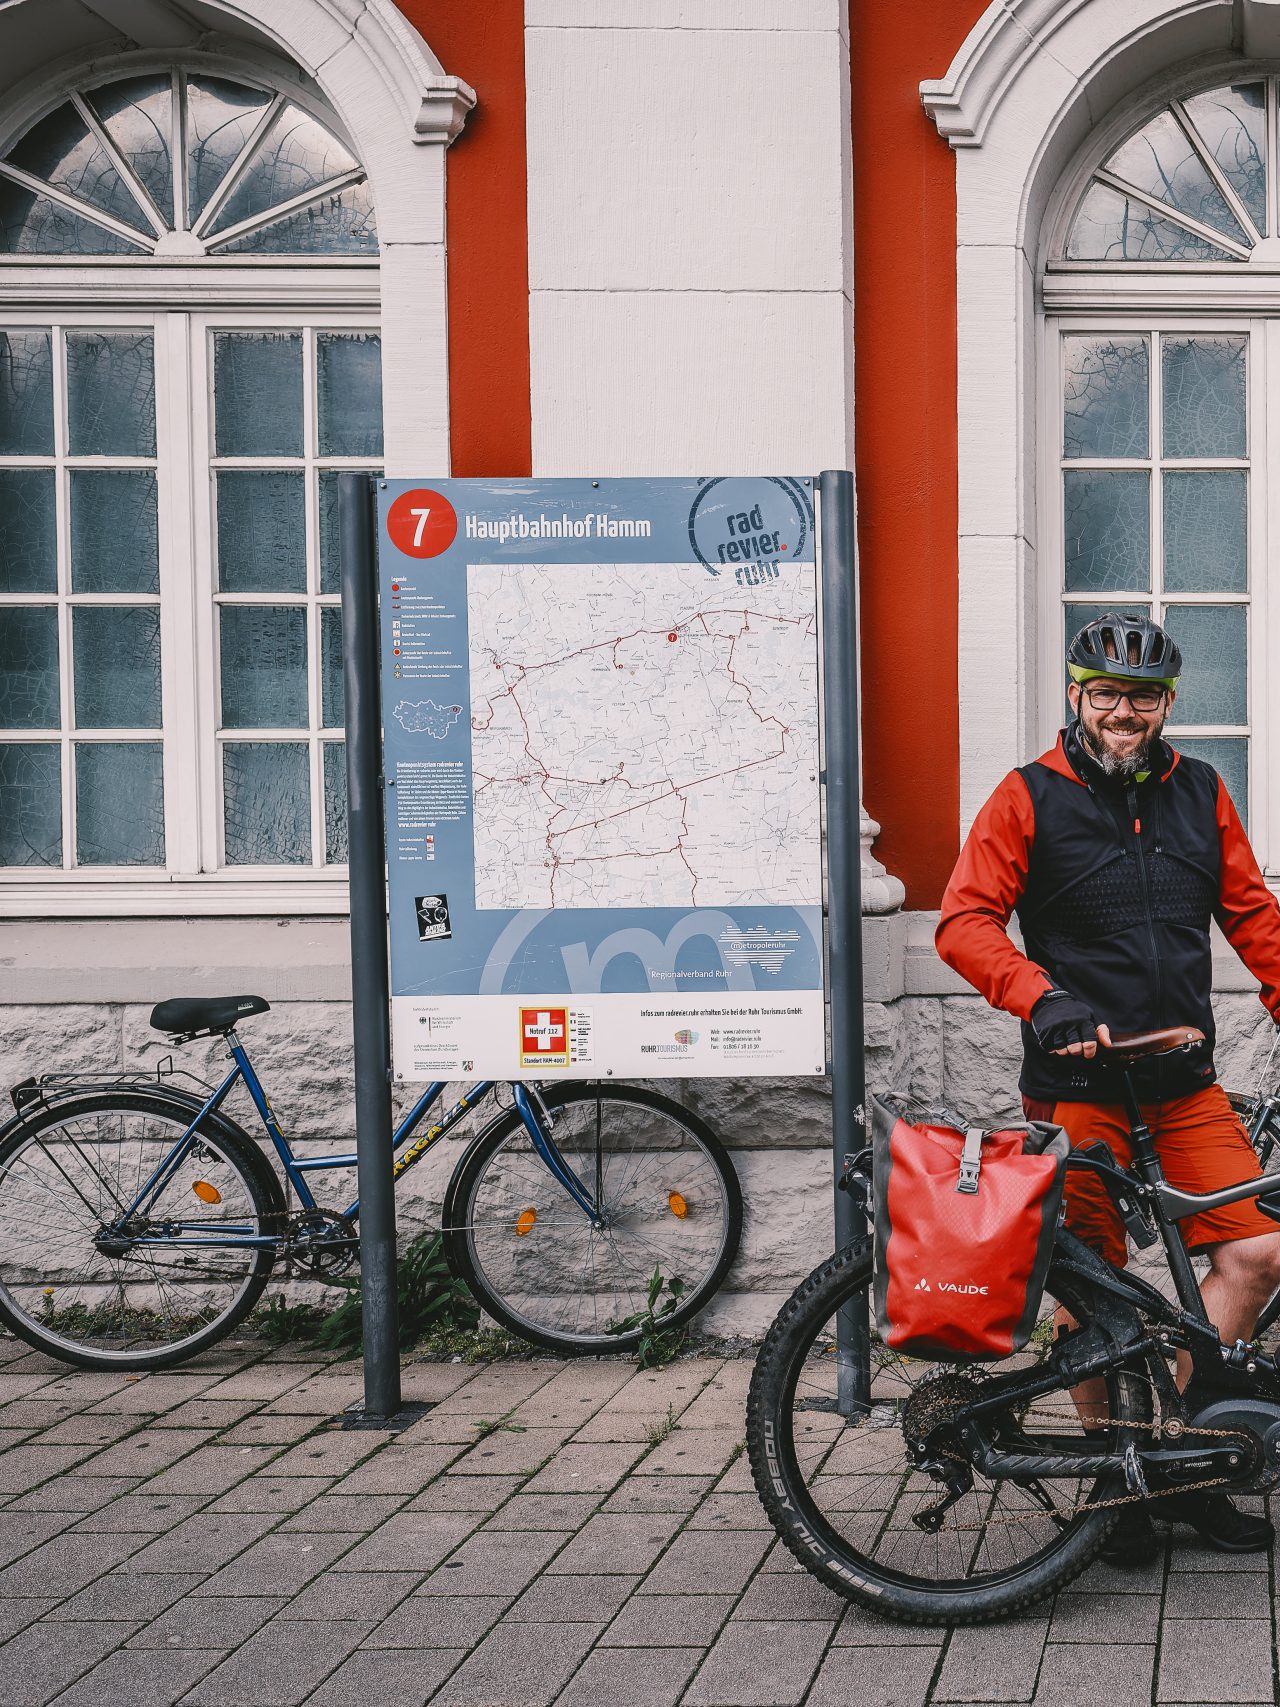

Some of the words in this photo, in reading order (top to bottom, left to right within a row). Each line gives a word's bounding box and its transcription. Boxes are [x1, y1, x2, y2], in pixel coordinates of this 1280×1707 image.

[410, 508, 431, 547] 7
[466, 514, 594, 543] Hauptbahnhof
[597, 515, 651, 538] Hamm
[727, 504, 763, 537] rad
[734, 556, 780, 586] ruhr
[731, 942, 786, 950] metropoleruhr
[651, 970, 713, 980] Regionalverband
[938, 1282, 989, 1295] VAUDE
[764, 1420, 795, 1512] NOBBY
